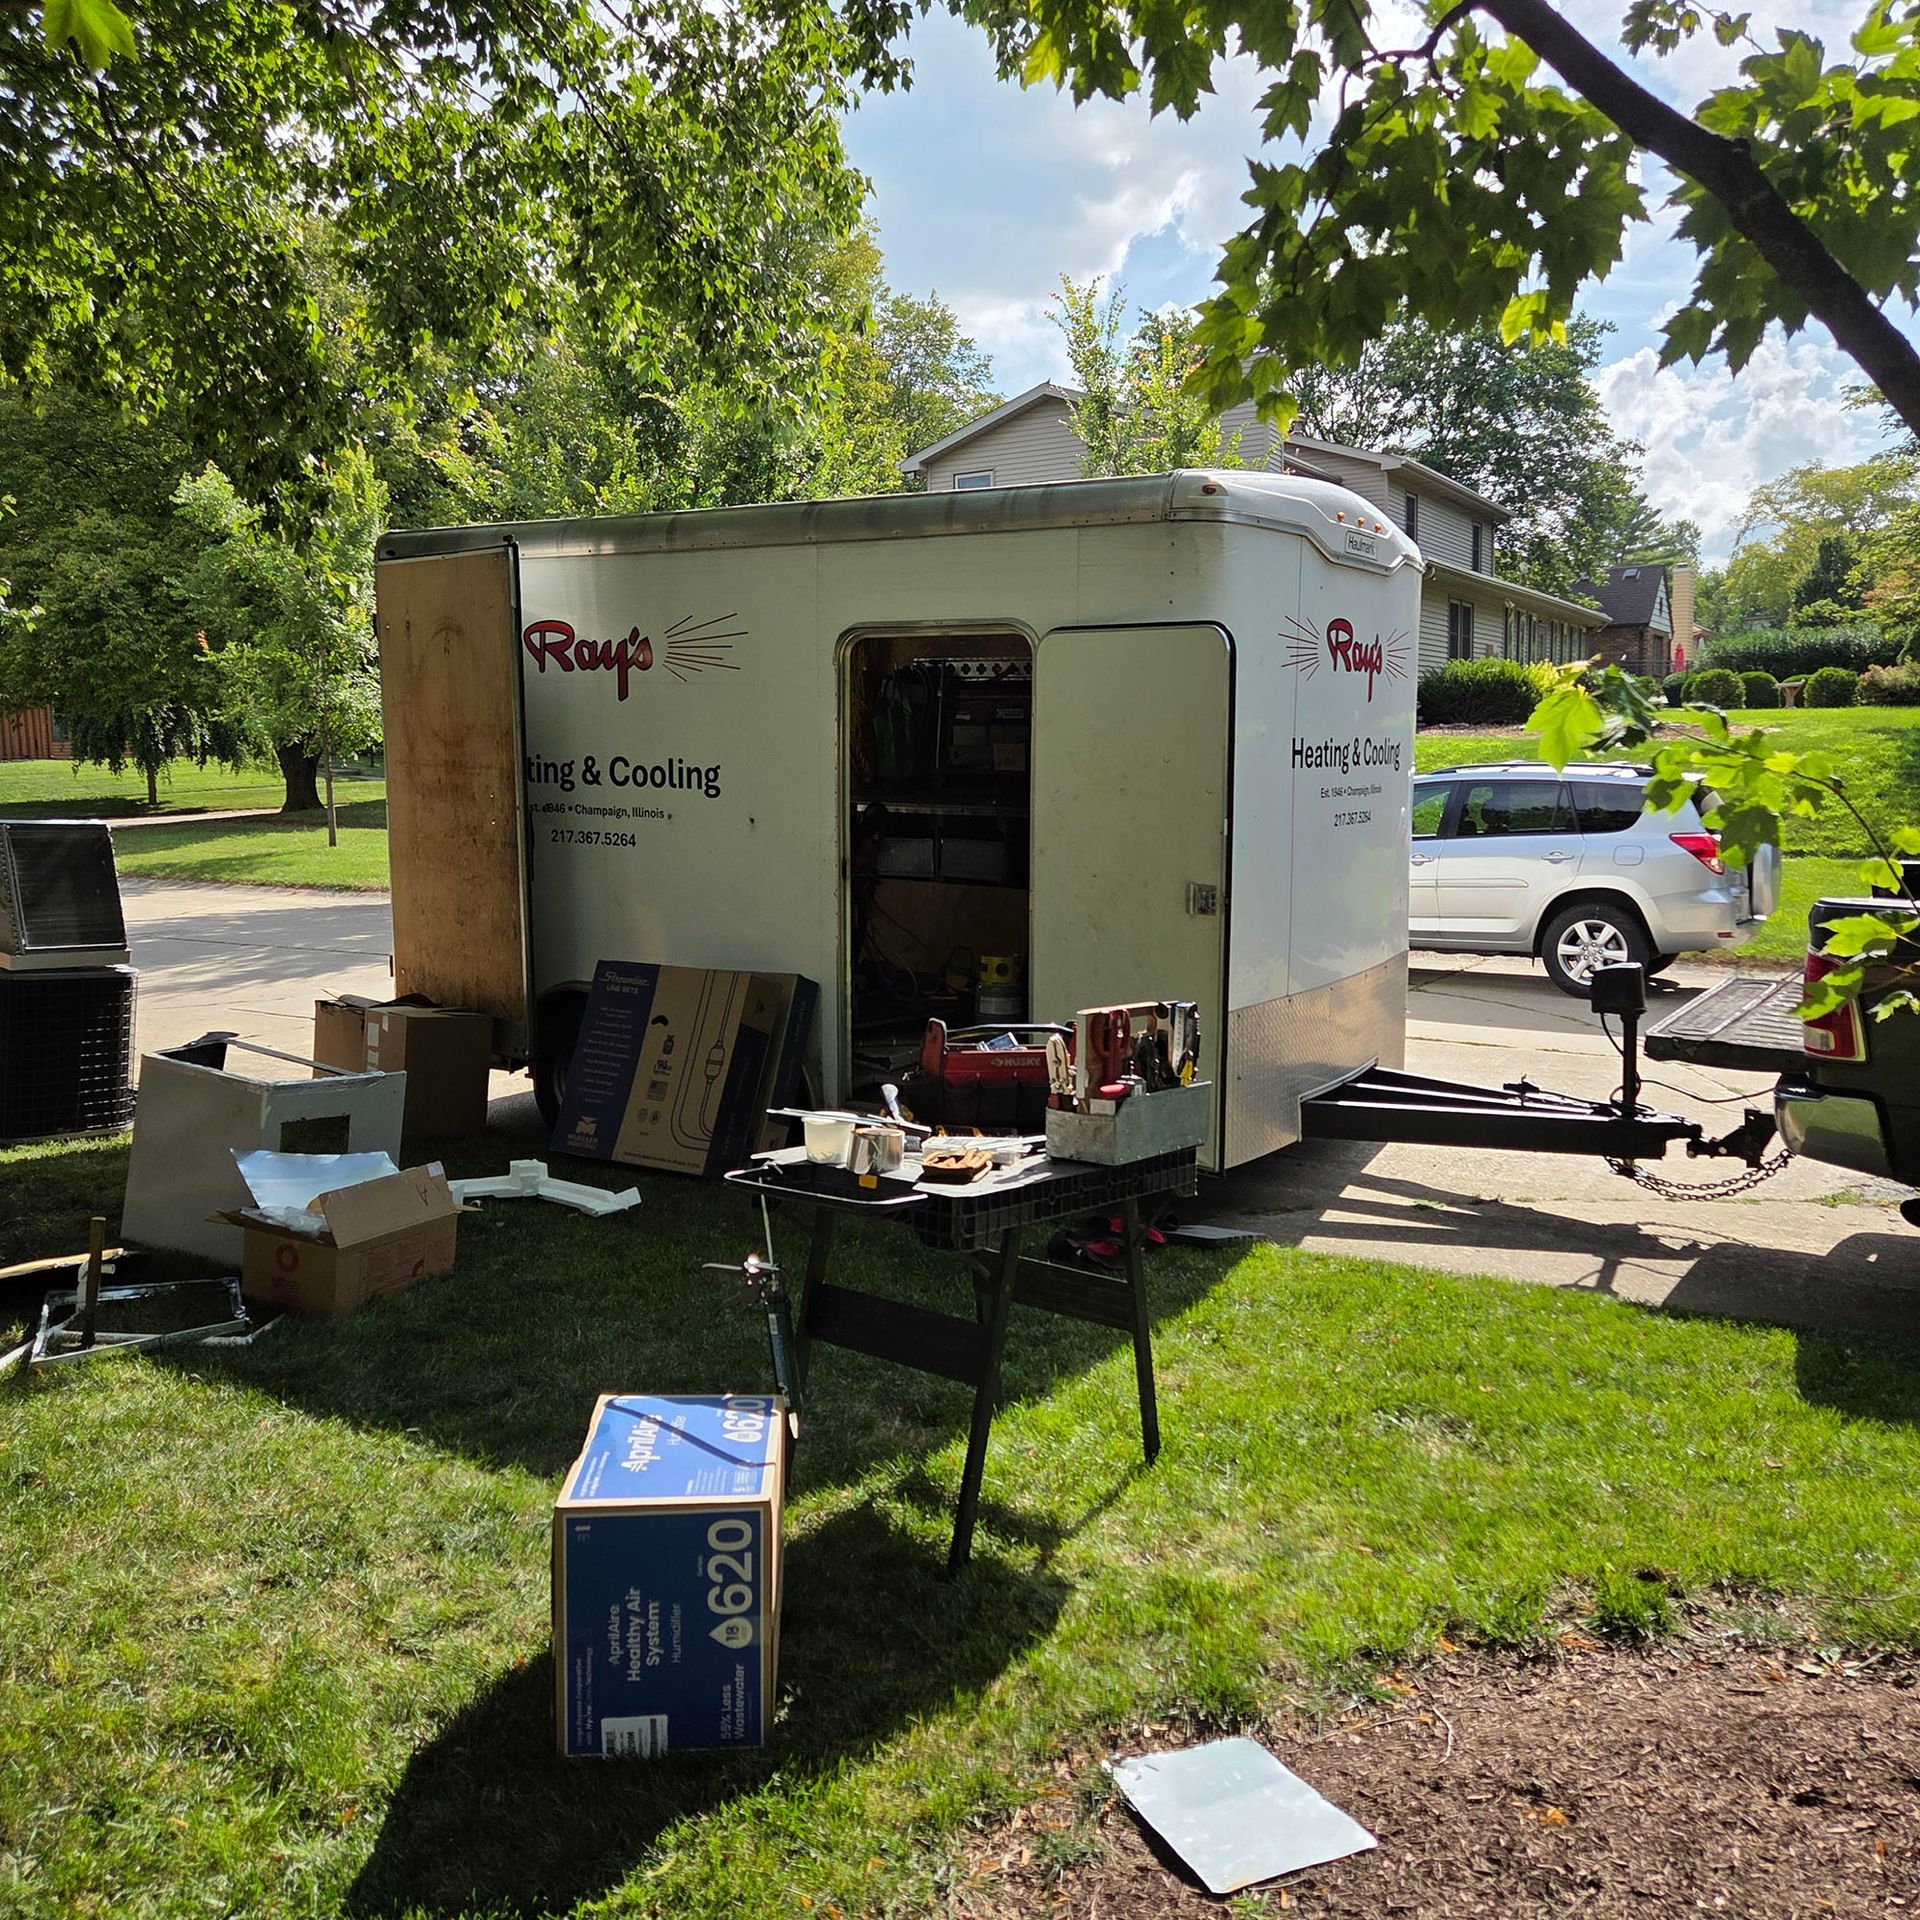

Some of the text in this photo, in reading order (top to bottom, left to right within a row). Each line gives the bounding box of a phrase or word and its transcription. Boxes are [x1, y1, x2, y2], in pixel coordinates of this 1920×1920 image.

[523, 619, 654, 702] Ray's
[1326, 617, 1383, 702] Ray's
[582, 756, 602, 785] &
[610, 757, 721, 799] Cooling
[1292, 737, 1400, 775] Heating & Cooling
[551, 829, 637, 848] 217.367.5264
[575, 804, 631, 820] Champaign,
[632, 806, 665, 819] Illinois
[1004, 1057, 1041, 1067] HUSKY
[707, 1519, 753, 1616] 620
[608, 1603, 624, 1665] AprilAire
[625, 1586, 646, 1682] Healthy Air
[646, 1600, 664, 1666] System
[671, 1603, 681, 1664] Humidifier
[725, 1625, 740, 1642] 18
[722, 1684, 732, 1711] Less
[734, 1664, 745, 1740] Wastewater
